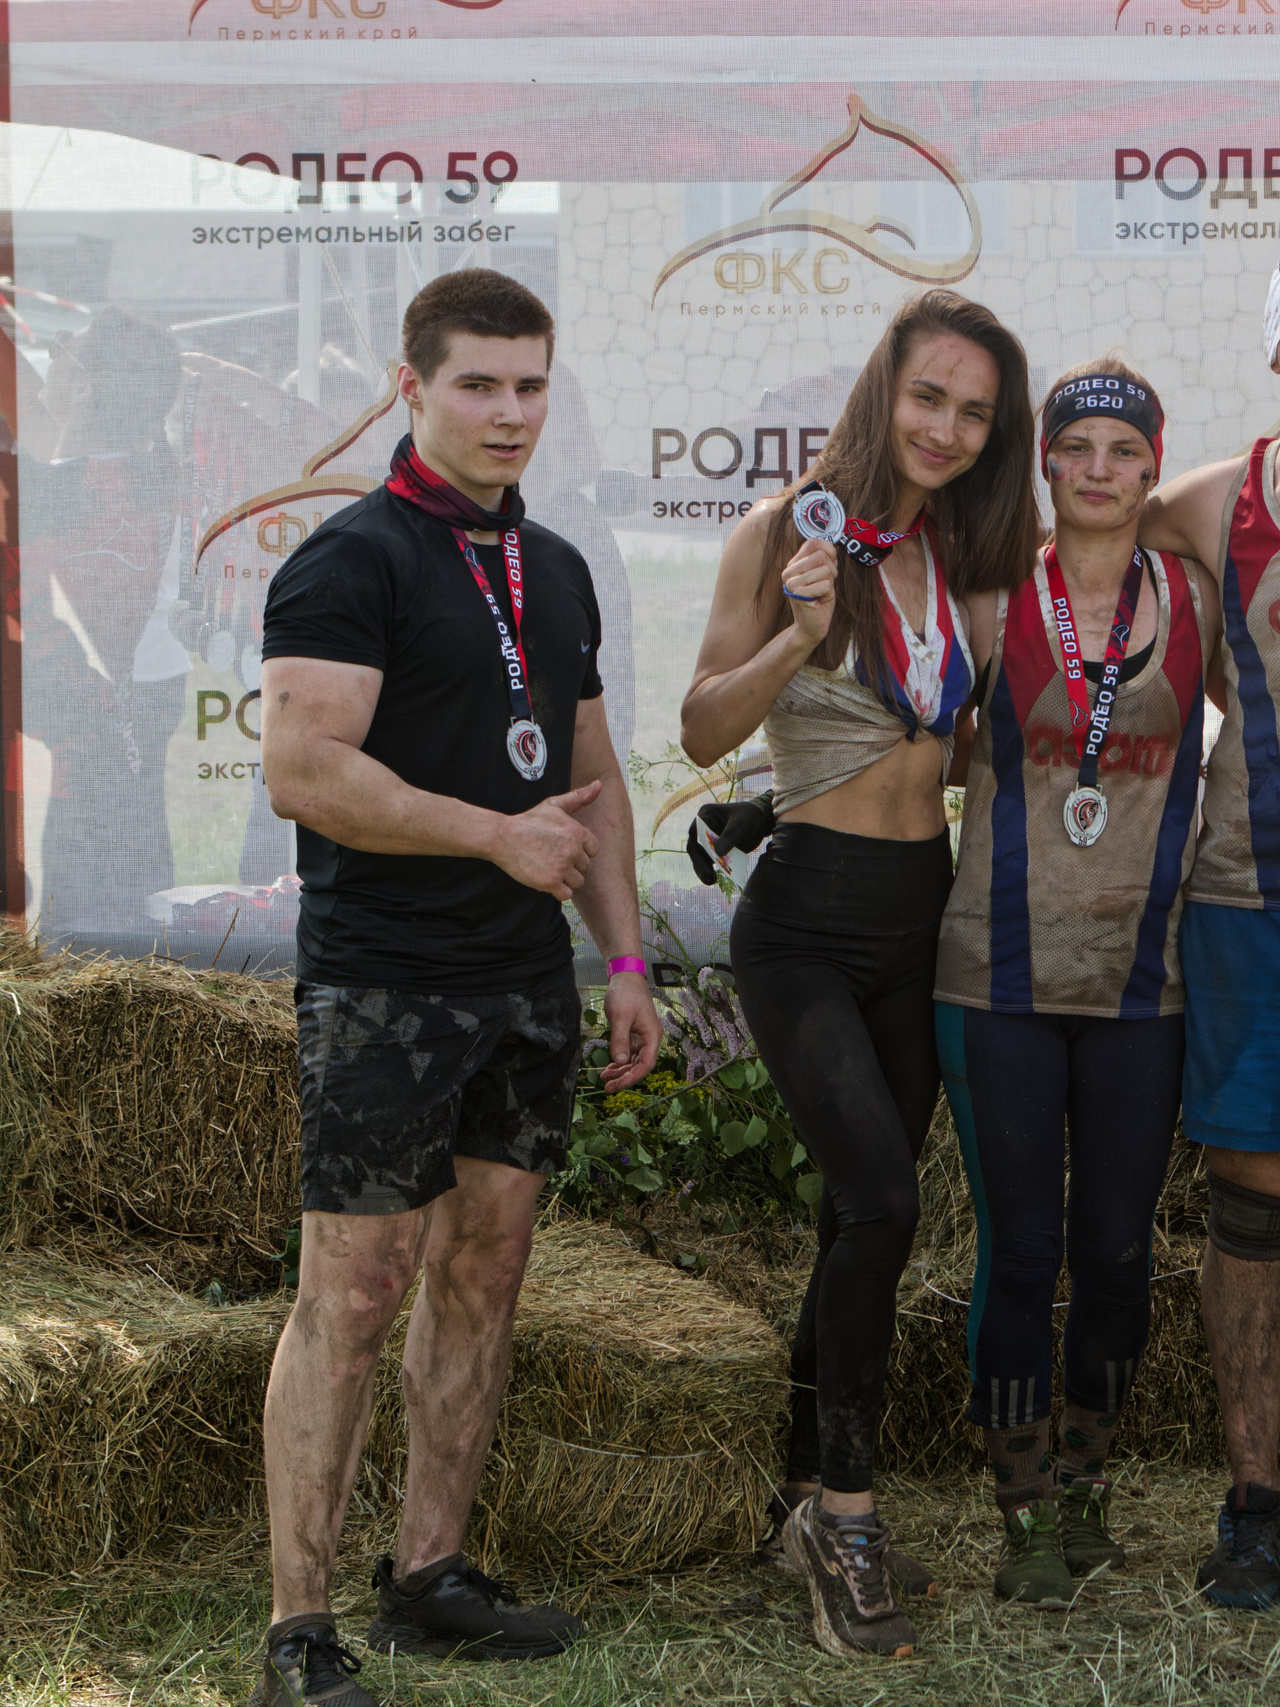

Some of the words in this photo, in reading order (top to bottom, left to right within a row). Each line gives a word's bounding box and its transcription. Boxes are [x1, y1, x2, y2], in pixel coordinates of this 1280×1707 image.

[218, 27, 346, 42] Пермский
[358, 27, 418, 42] край
[1144, 21, 1275, 38] Пермский
[190, 151, 423, 213] РОДЕО
[445, 150, 518, 204] 59
[191, 221, 423, 249] экстремальный
[433, 220, 516, 243] забег
[714, 248, 850, 295] ФКС
[680, 302, 809, 318] Пермский
[820, 302, 882, 318] край
[1055, 378, 1120, 404] РОДЕО
[1126, 383, 1147, 402] 59
[1074, 394, 1124, 411] 2620
[651, 426, 829, 488] РОДЕ
[504, 527, 522, 583] ОДЕО
[485, 593, 501, 617] 59
[511, 585, 523, 610] 59
[1053, 597, 1077, 654] РОДЕО
[1066, 659, 1082, 680] 59
[497, 620, 524, 690] РОДЕО
[1086, 691, 1113, 756] РОДЕО
[1104, 664, 1120, 686] 59
